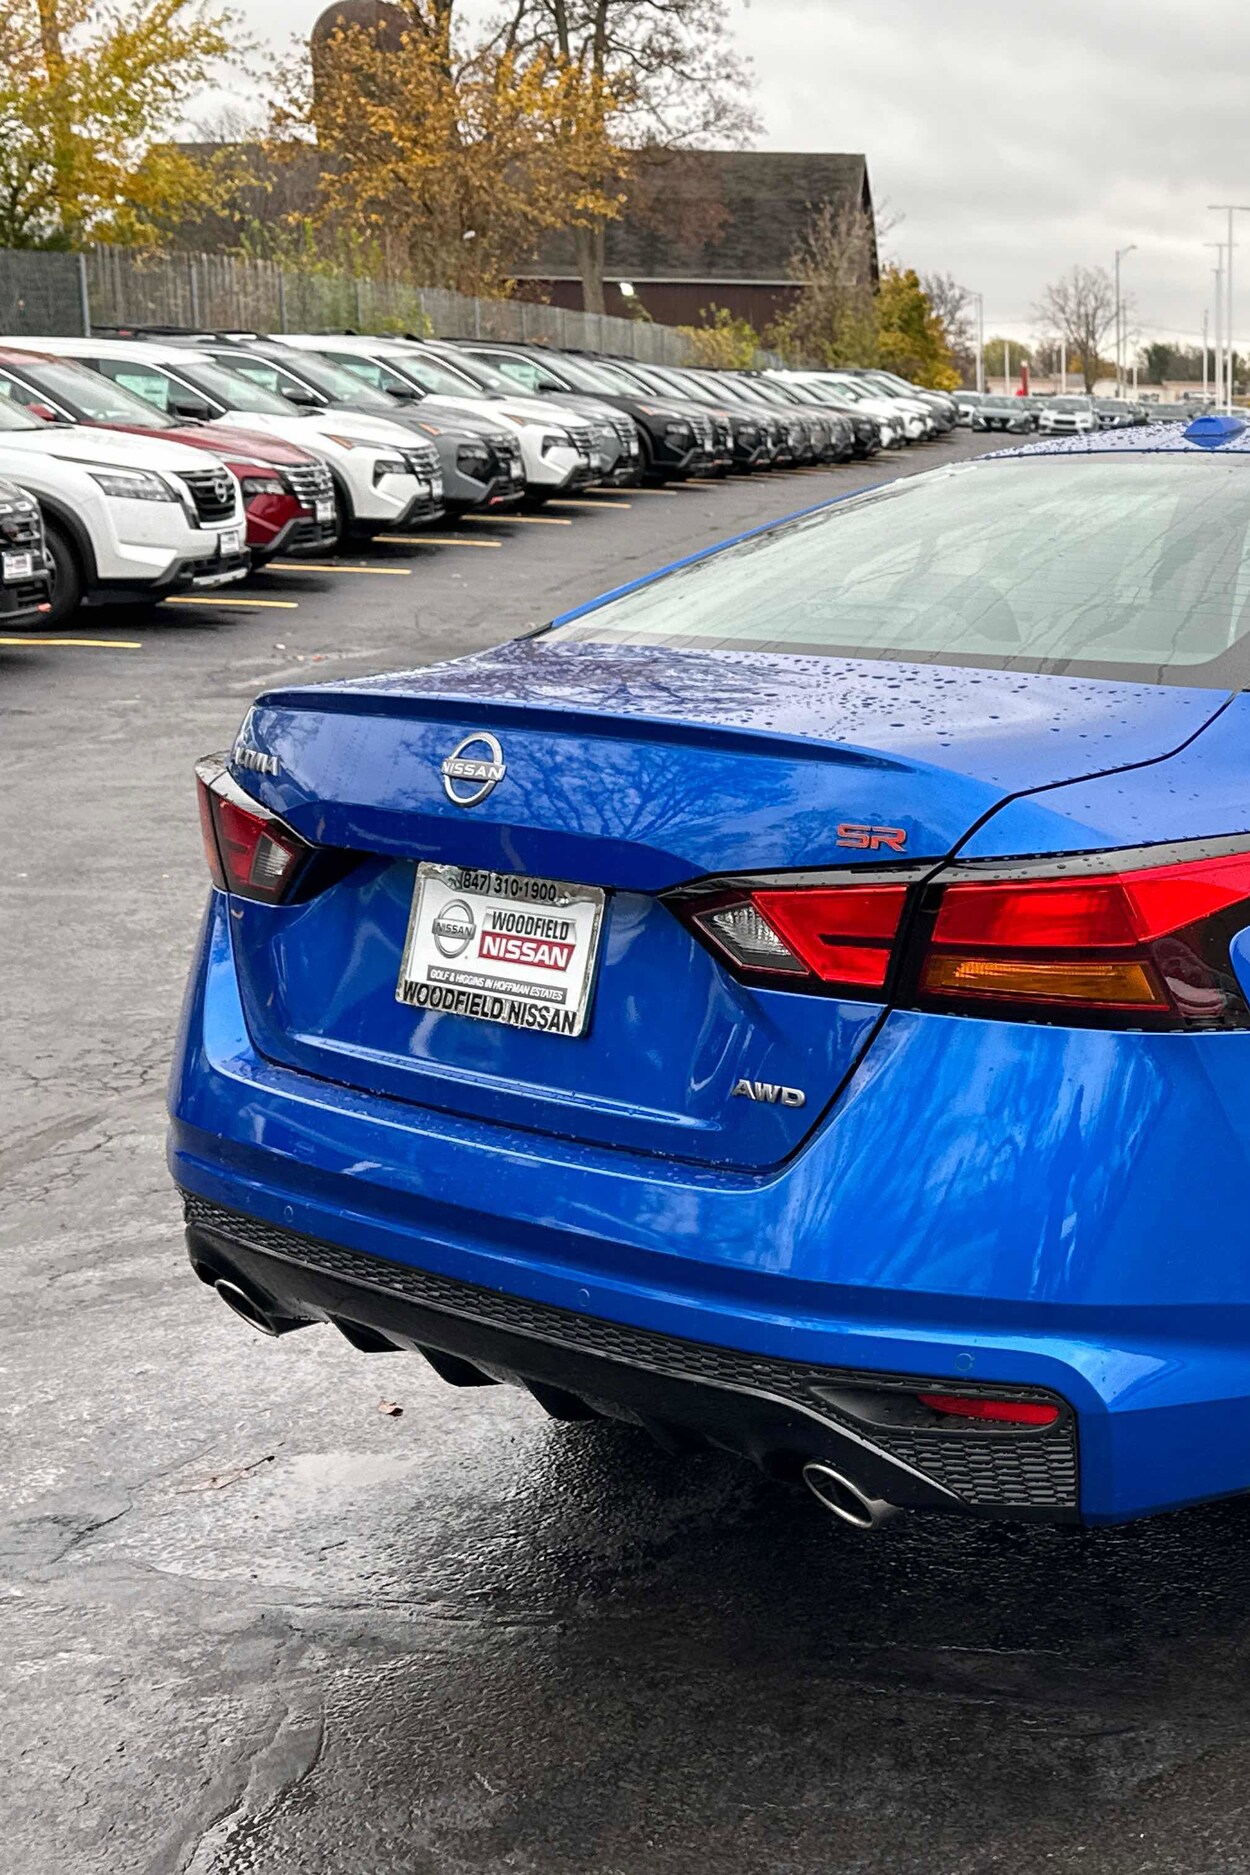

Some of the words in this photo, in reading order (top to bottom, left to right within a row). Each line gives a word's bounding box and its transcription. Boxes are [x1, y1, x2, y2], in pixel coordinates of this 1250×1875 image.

[442, 761, 503, 780] NISSAN
[836, 823, 907, 852] SR
[460, 871, 491, 894] (847)
[436, 921, 474, 937] NISSAN
[492, 911, 569, 941] WOODFIELD
[482, 935, 568, 968] NISSAN
[430, 969, 450, 980] GOLF
[449, 972, 455, 981] &
[455, 973, 485, 987] HIGGINS
[484, 979, 494, 989] IN
[493, 980, 530, 995] HOFFMAN
[529, 986, 564, 1001] ESTATES
[403, 980, 503, 1019] WOODFIELD
[508, 999, 577, 1034] NISSAN
[732, 1079, 805, 1107] AWD
